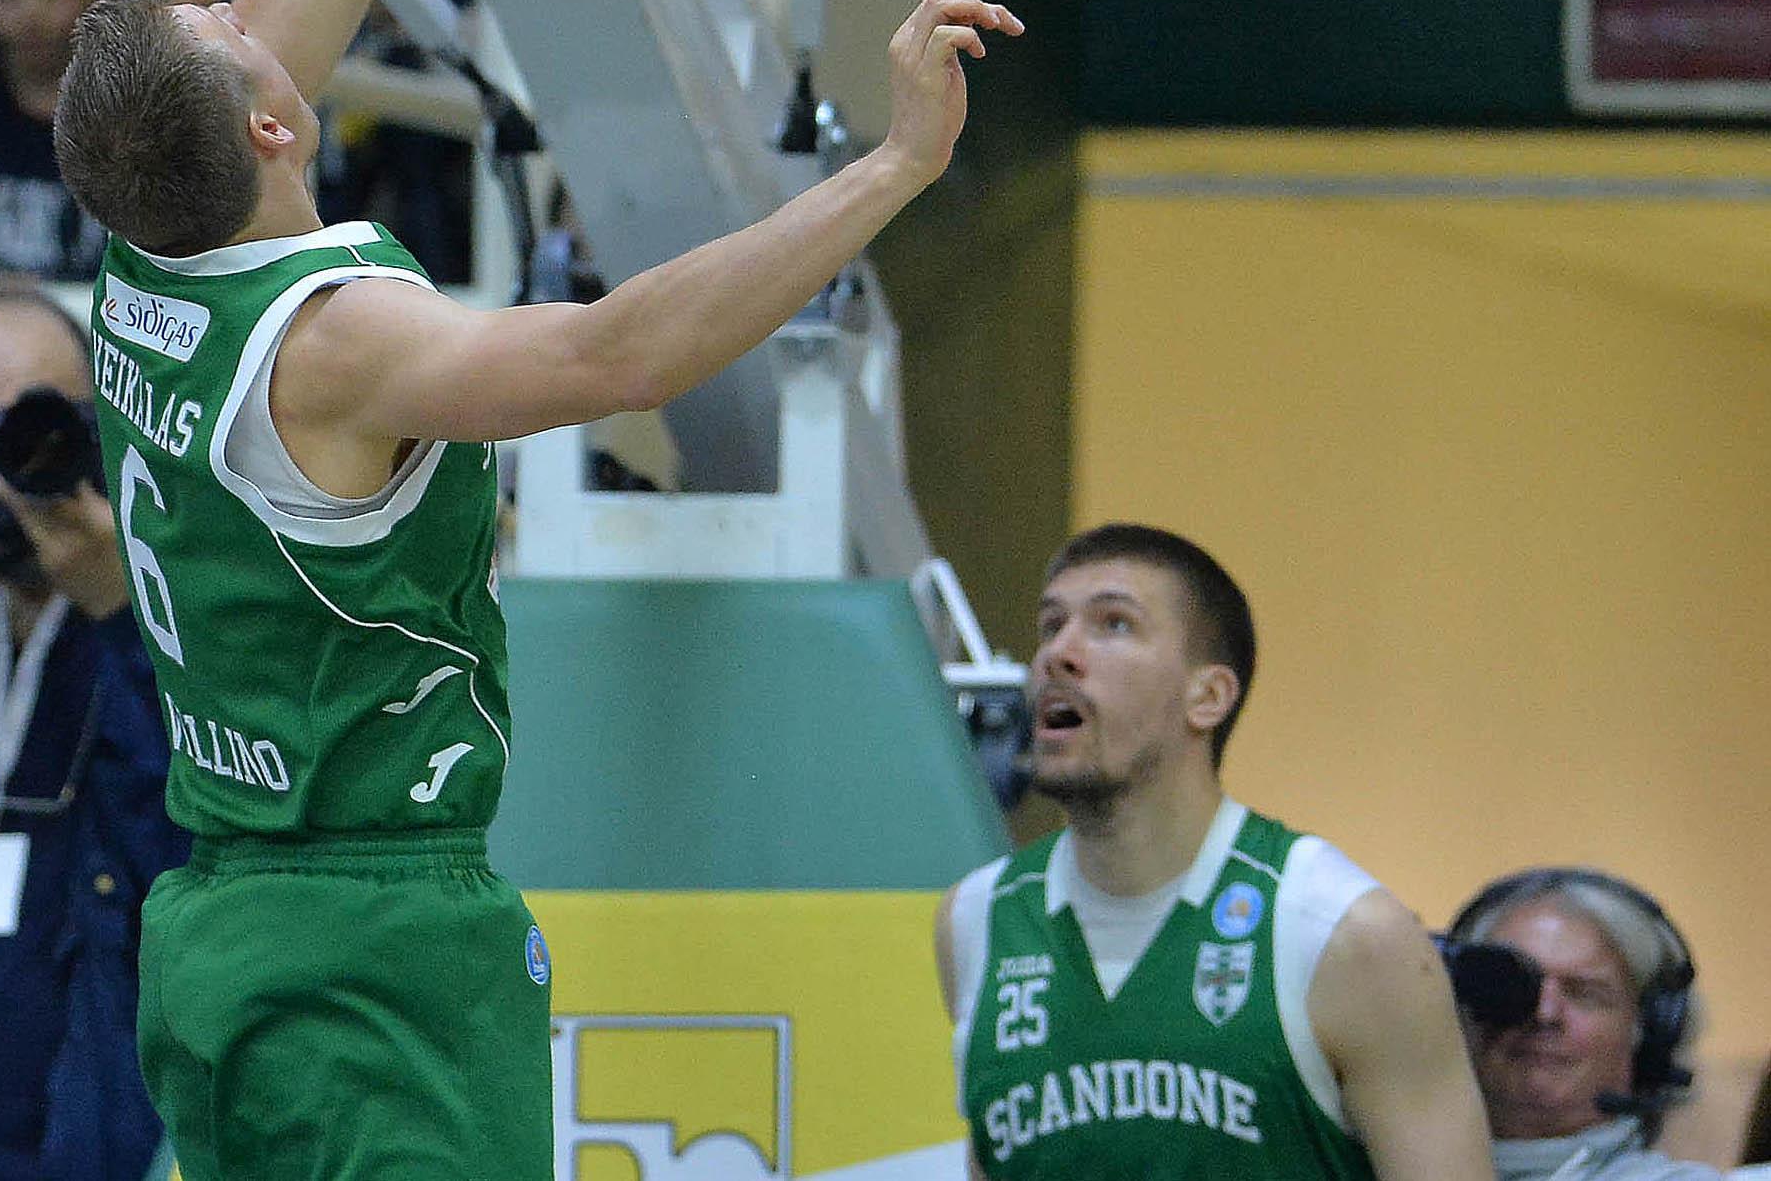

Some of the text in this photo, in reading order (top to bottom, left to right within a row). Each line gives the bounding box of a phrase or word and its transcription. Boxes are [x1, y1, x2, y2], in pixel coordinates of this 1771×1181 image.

[120, 444, 184, 667] 6
[996, 978, 1049, 1051] 25
[985, 1060, 1264, 1162] SCANDONE
